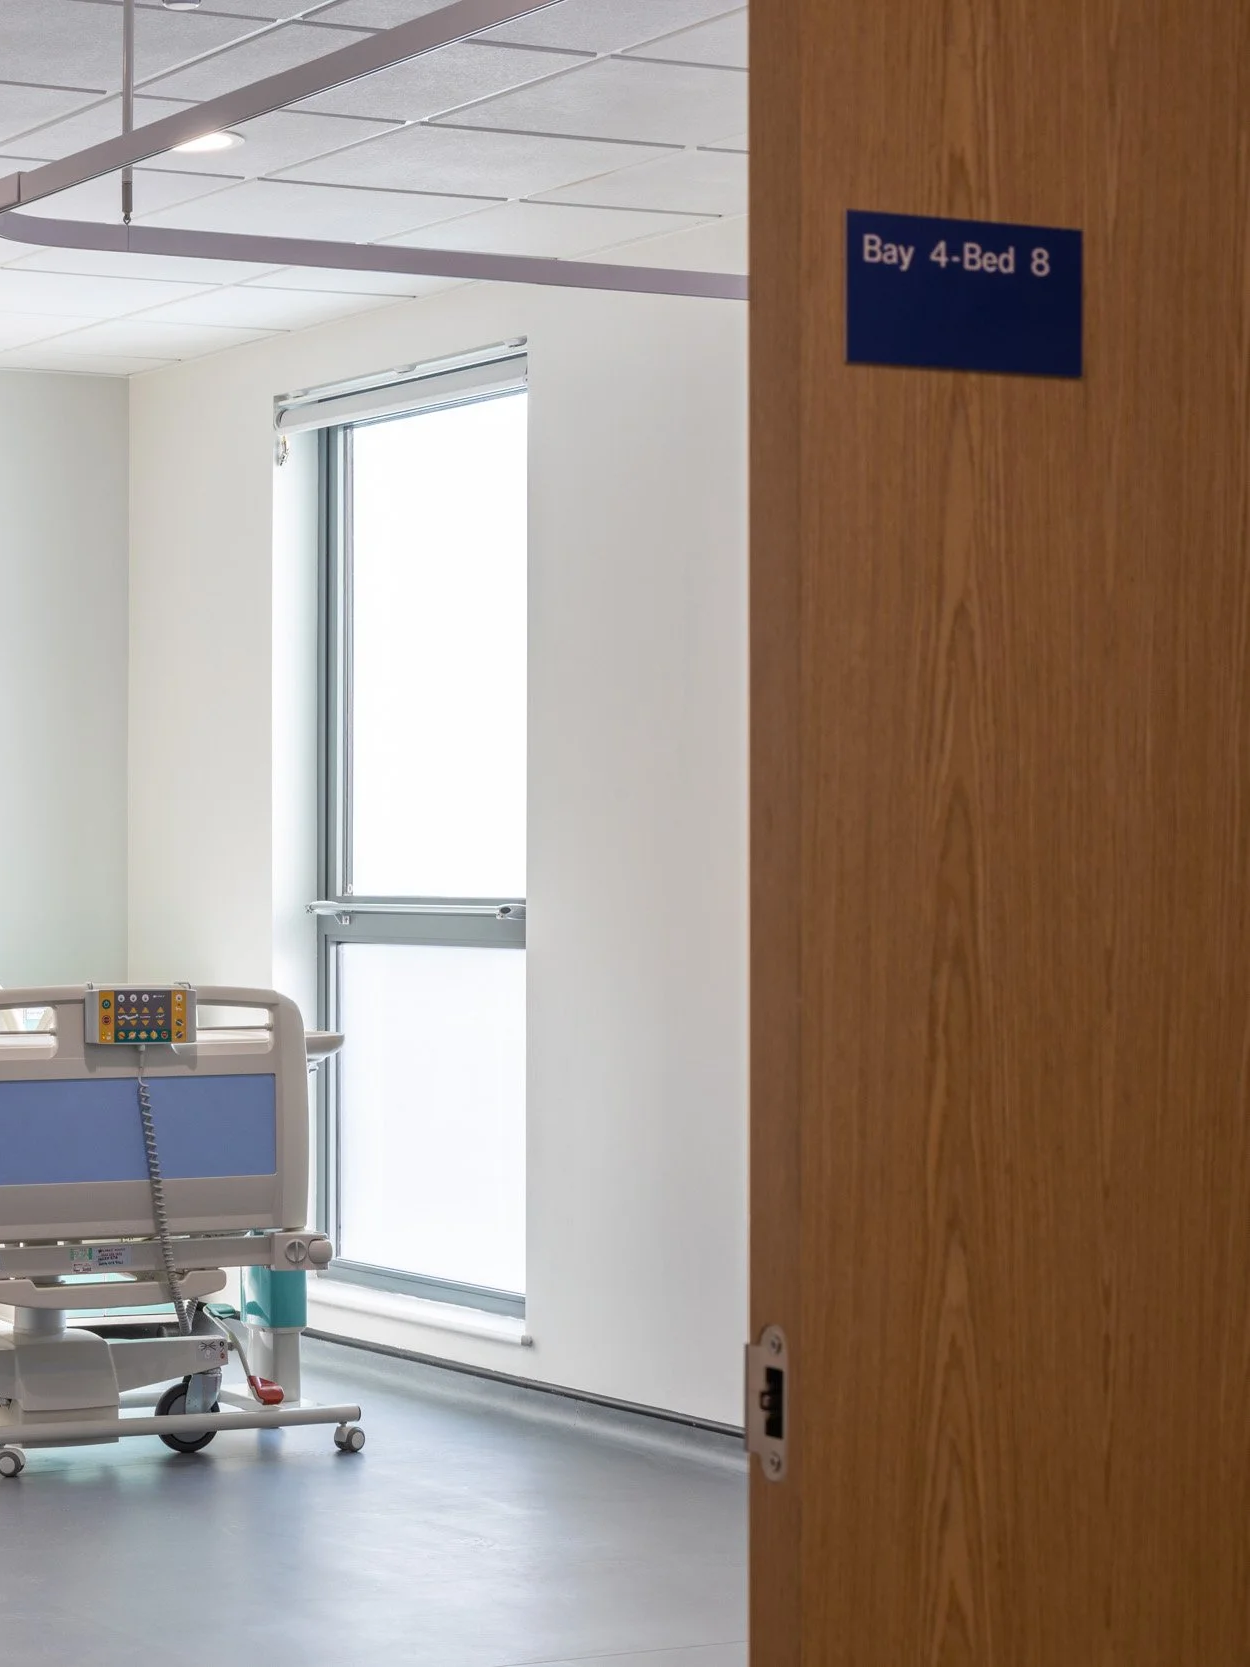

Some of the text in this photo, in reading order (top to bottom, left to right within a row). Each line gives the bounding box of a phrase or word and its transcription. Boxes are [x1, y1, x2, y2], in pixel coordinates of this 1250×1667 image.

[863, 233, 1050, 277] Bay 4-Bed 8
